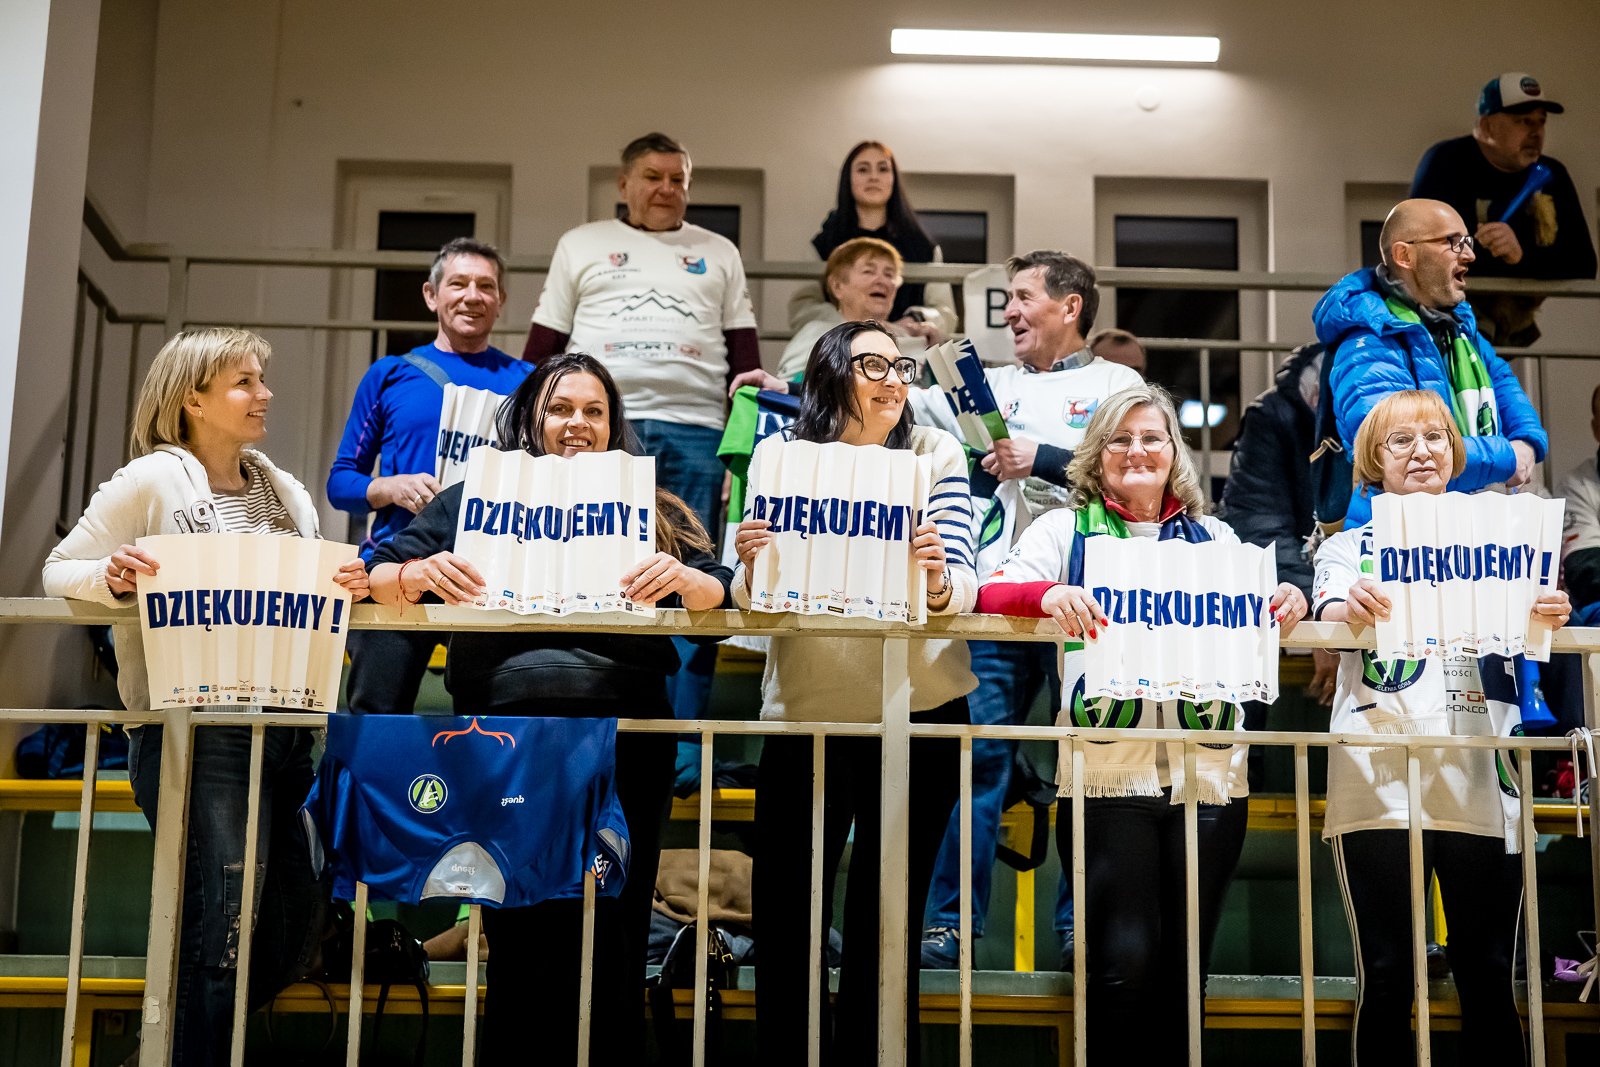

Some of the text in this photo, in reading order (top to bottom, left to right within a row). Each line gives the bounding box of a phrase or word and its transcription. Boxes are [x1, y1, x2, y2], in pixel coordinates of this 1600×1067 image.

[463, 497, 632, 544] DZIĘKUJEMY
[1380, 543, 1536, 589] DZIĘKUJEMY
[147, 589, 328, 632] DZIĘKUJEMY
[1092, 586, 1264, 630] DZIĘKUJEMY
[501, 795, 525, 807] quest
